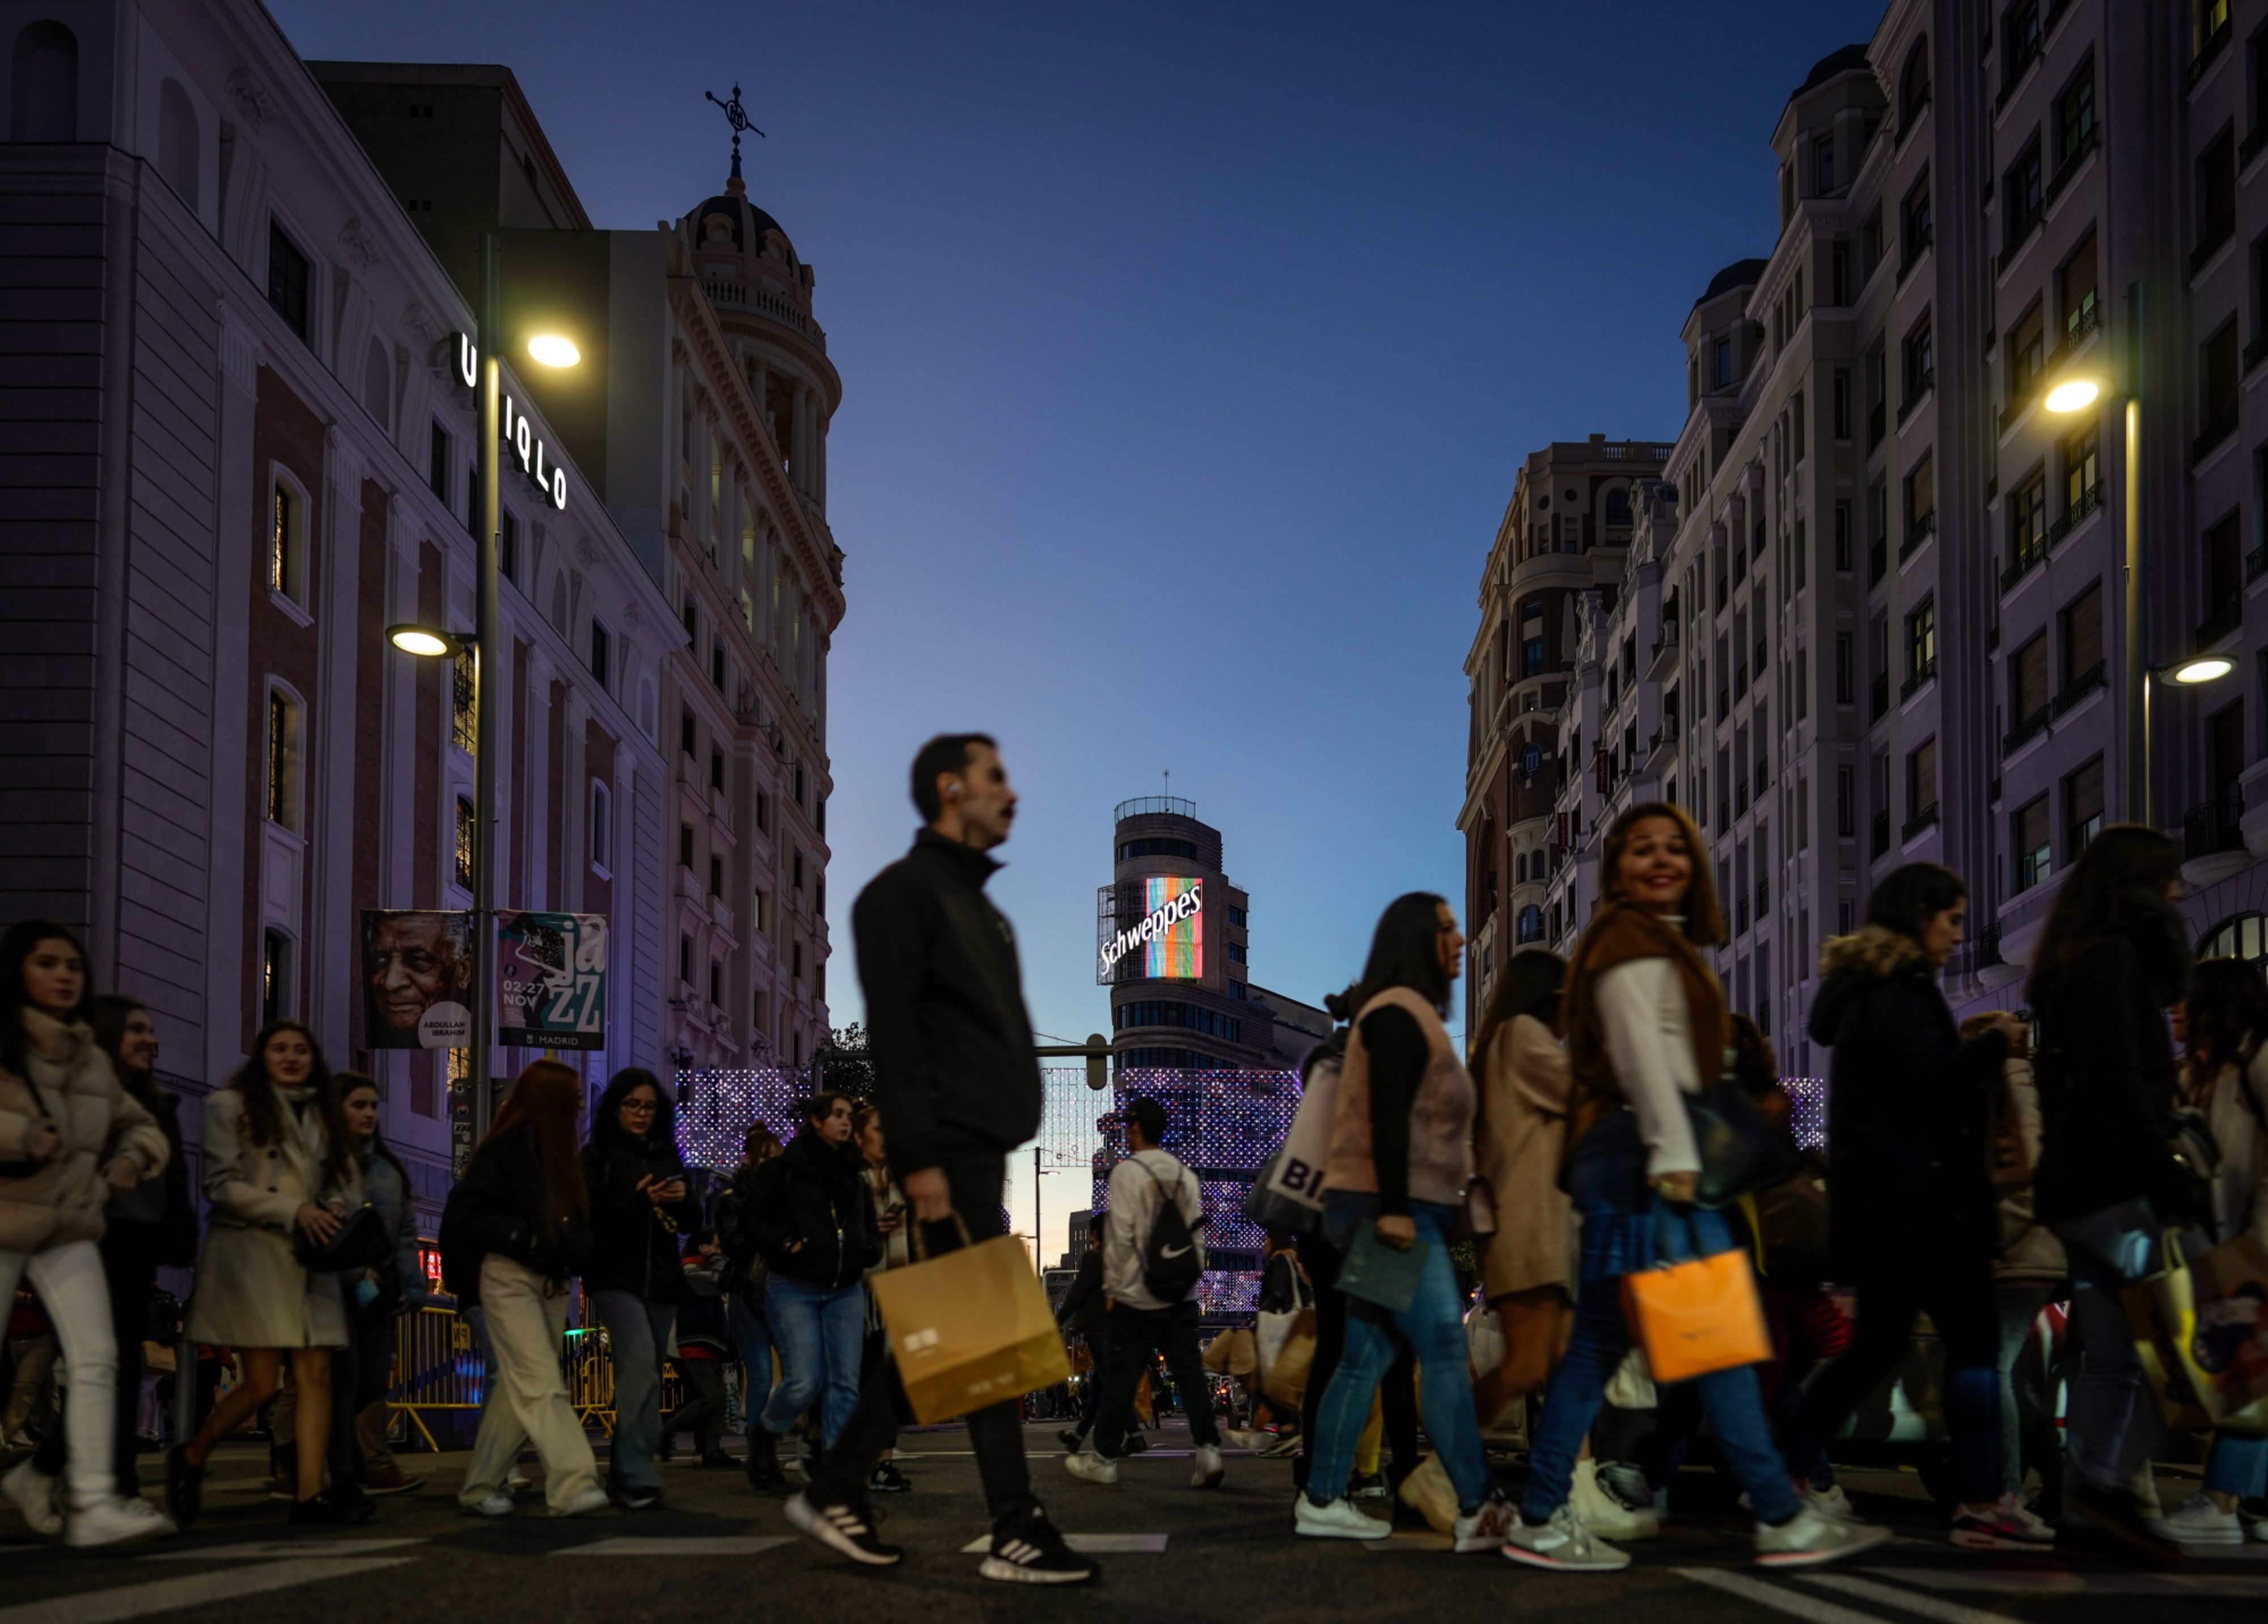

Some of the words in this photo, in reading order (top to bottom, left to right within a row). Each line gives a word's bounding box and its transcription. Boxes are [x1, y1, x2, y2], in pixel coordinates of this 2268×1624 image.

[461, 333, 566, 510] UIQLO
[1101, 886, 1200, 976] Schweppes
[503, 980, 545, 995] 02-27
[503, 994, 539, 1008] NOV
[539, 1037, 578, 1046] MADRID
[1281, 1157, 1325, 1203] BI
